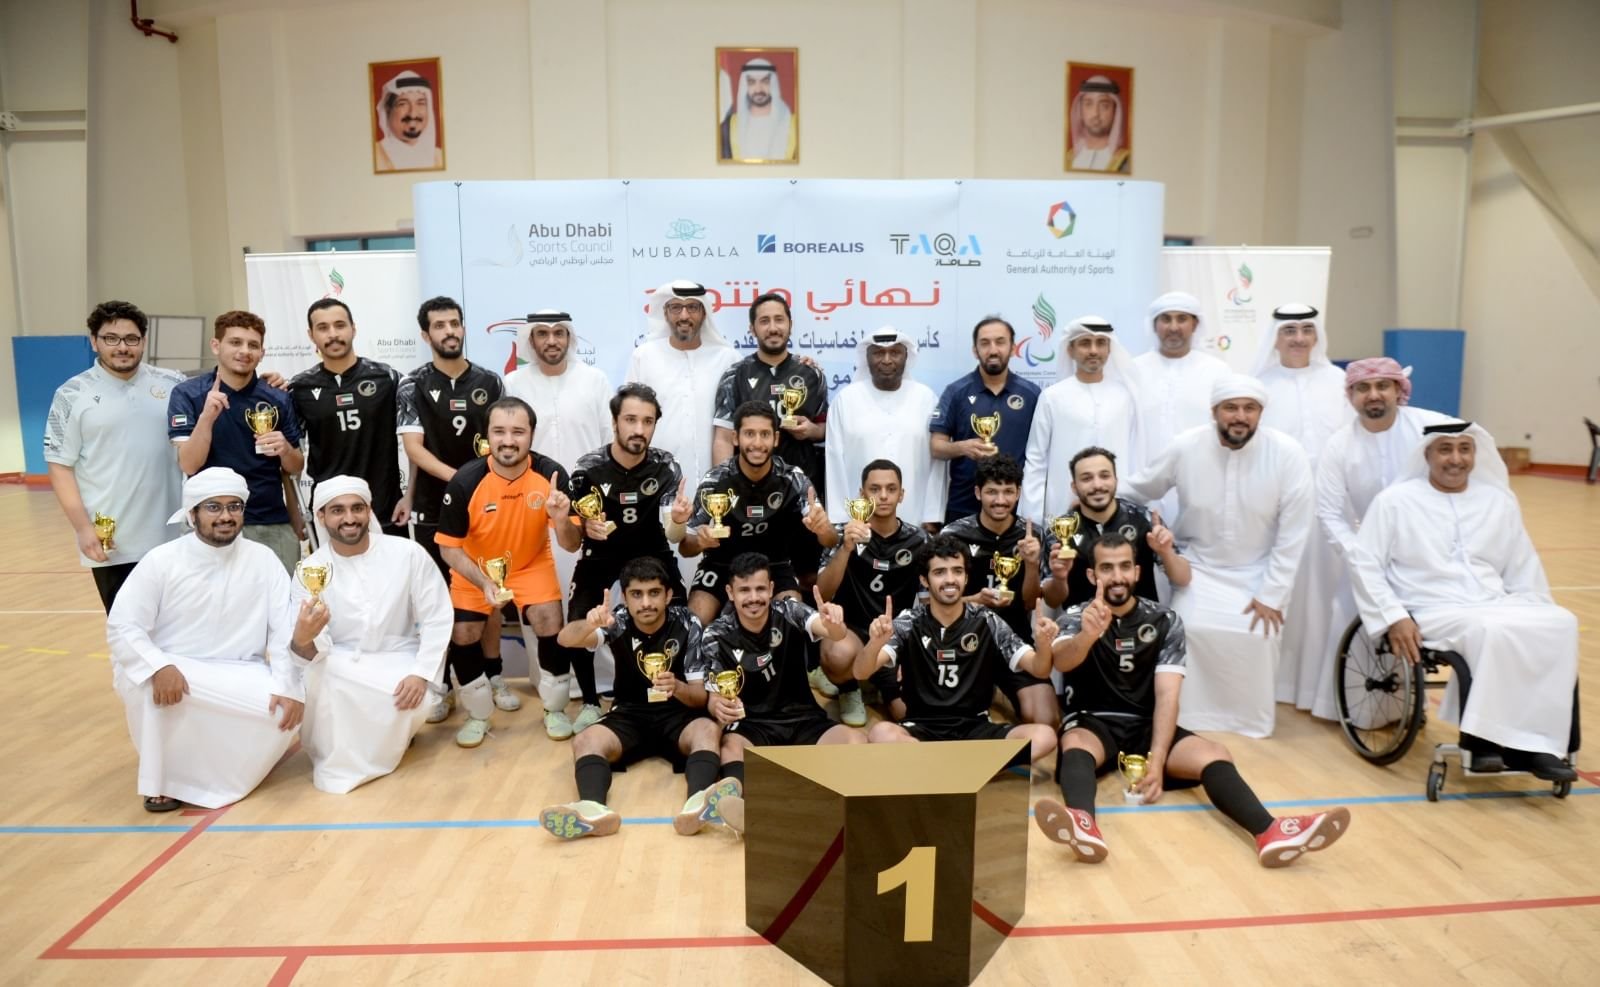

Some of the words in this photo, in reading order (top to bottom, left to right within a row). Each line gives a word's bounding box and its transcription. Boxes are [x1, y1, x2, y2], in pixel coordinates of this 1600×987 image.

[528, 223, 560, 238] Abu
[565, 223, 612, 238] Dhabi
[528, 240, 567, 254] Sports
[570, 240, 612, 253] Council
[783, 242, 864, 253] BOREALIS
[889, 232, 982, 256] TAQA
[632, 246, 739, 258] MUBADALA
[1006, 248, 1046, 260] للرياضة
[1046, 248, 1085, 258] العامة
[1086, 248, 1116, 260] الهيئة
[529, 256, 558, 266] الرياضي
[559, 255, 588, 266] أبوظبي
[589, 256, 614, 265] مجلس
[1006, 264, 1038, 274] General
[1040, 264, 1077, 276] Authority
[1078, 264, 1086, 274] of
[1087, 264, 1115, 276] Sports
[806, 279, 940, 321] نهائي
[377, 338, 392, 346] Abu
[394, 338, 416, 346] Dhabi
[336, 408, 362, 432] 15
[452, 415, 467, 436] 9
[622, 507, 638, 524] 8
[741, 521, 768, 537] 20
[691, 569, 719, 588] 20
[869, 573, 885, 592] 6
[1118, 654, 1135, 673] 5
[761, 662, 776, 682] 11
[937, 664, 959, 688] 13
[876, 846, 937, 943] 1
